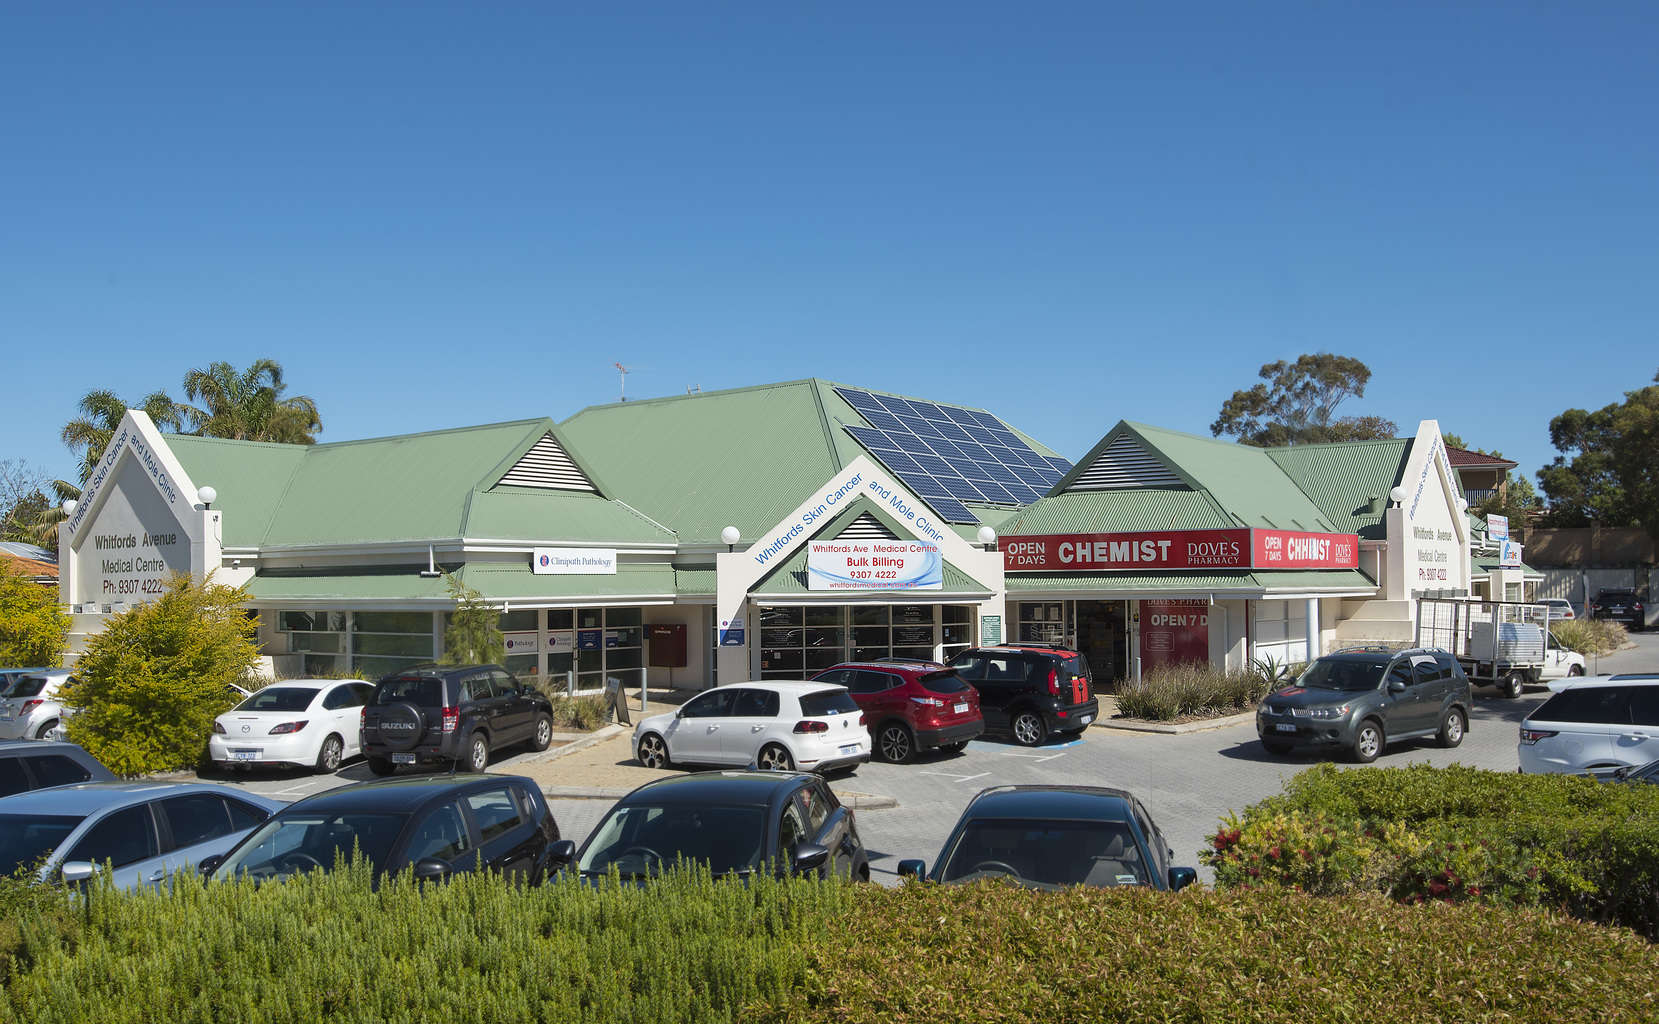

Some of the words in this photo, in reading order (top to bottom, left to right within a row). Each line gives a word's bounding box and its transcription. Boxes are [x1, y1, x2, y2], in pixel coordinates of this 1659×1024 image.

[68, 489, 95, 534] Whitfords
[93, 465, 108, 489] Skin
[106, 428, 128, 466] Cancer
[131, 434, 145, 455] and
[143, 450, 158, 477] Mole
[158, 473, 176, 503] Clinic
[754, 523, 804, 565] Whitfords
[802, 504, 827, 525] Skin
[825, 472, 863, 505] Cancer
[869, 481, 891, 499] and
[889, 495, 914, 520] Mole
[95, 533, 137, 550] Whitfords
[142, 531, 177, 547] Avenue
[1264, 536, 1282, 549] OPEN
[813, 544, 851, 553] Whitfords
[853, 544, 868, 553] Ave
[873, 544, 907, 553] Medical
[909, 544, 938, 553] Centre
[1008, 542, 1045, 554] OPEN
[1058, 540, 1172, 563] CHEMIST
[1008, 556, 1014, 565] 7
[1018, 555, 1046, 565] DAYS
[1188, 556, 1240, 565] PHARMACY
[1269, 551, 1282, 561] DAYS
[102, 558, 133, 574] Medical
[135, 556, 164, 572] Centre
[582, 557, 612, 568] Pathology
[847, 557, 869, 567] Bulk
[872, 557, 904, 569] Billing
[850, 570, 872, 579] 9307
[874, 570, 897, 579] 4222
[103, 580, 117, 594] Ph:
[119, 579, 139, 594] 9307
[141, 578, 163, 594] 4222
[1151, 614, 1187, 626] OPEN
[1189, 614, 1197, 626] 7
[381, 722, 416, 730] SUZUKI
